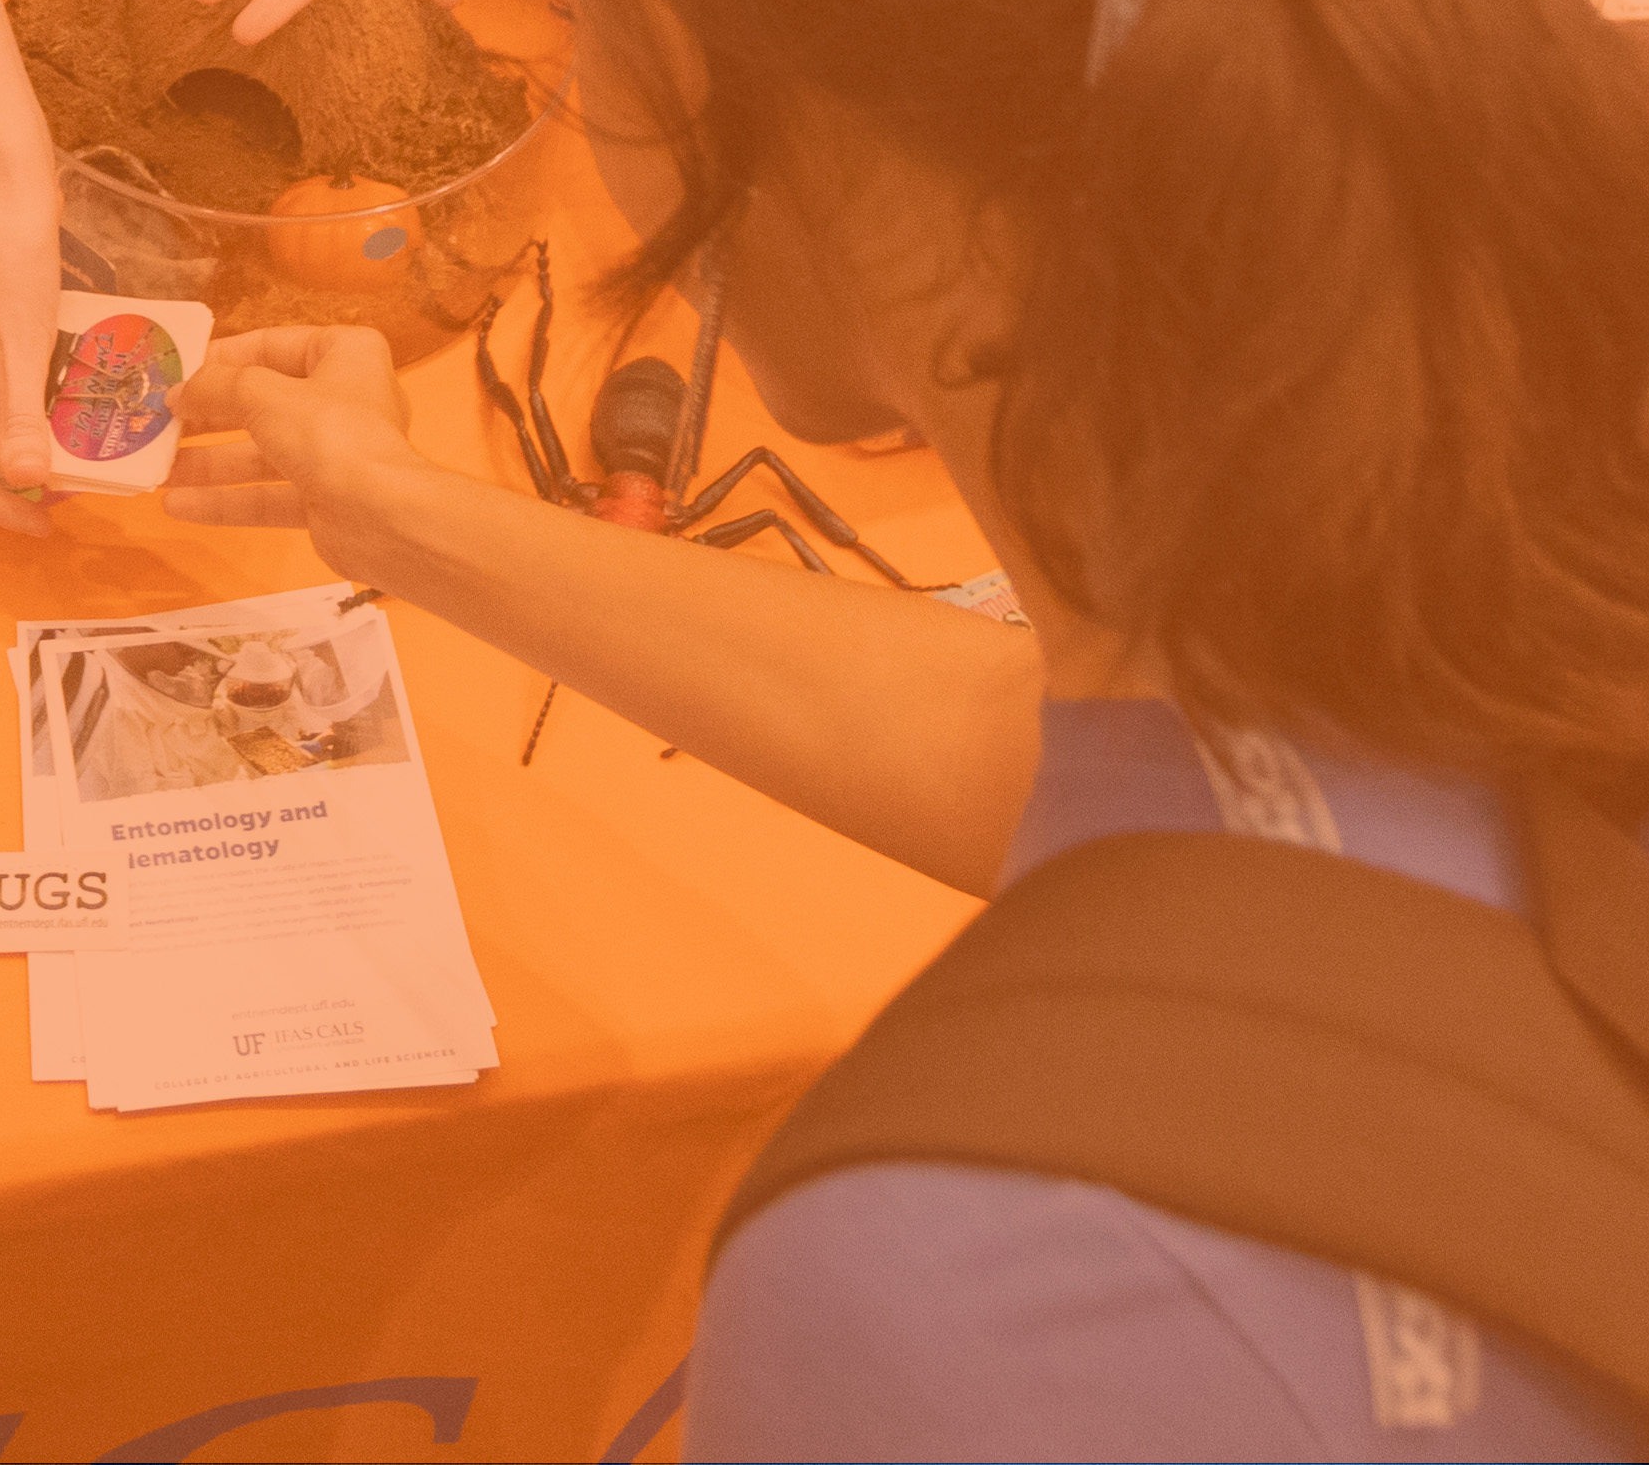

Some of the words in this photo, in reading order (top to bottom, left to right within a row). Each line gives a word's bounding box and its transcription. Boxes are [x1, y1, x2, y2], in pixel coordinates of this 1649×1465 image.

[110, 809, 273, 843] Entomology
[279, 799, 329, 824] and
[231, 1030, 268, 1058] UF
[273, 1026, 314, 1046] IFAS
[315, 1019, 367, 1041] CALS
[152, 1075, 212, 1093] COLLEGE
[213, 1073, 231, 1085] OF
[234, 1061, 330, 1082] AGRICULTURAL
[333, 1057, 361, 1071] AND
[363, 1053, 391, 1068] LIFE
[394, 1047, 457, 1064] SCIENCES
